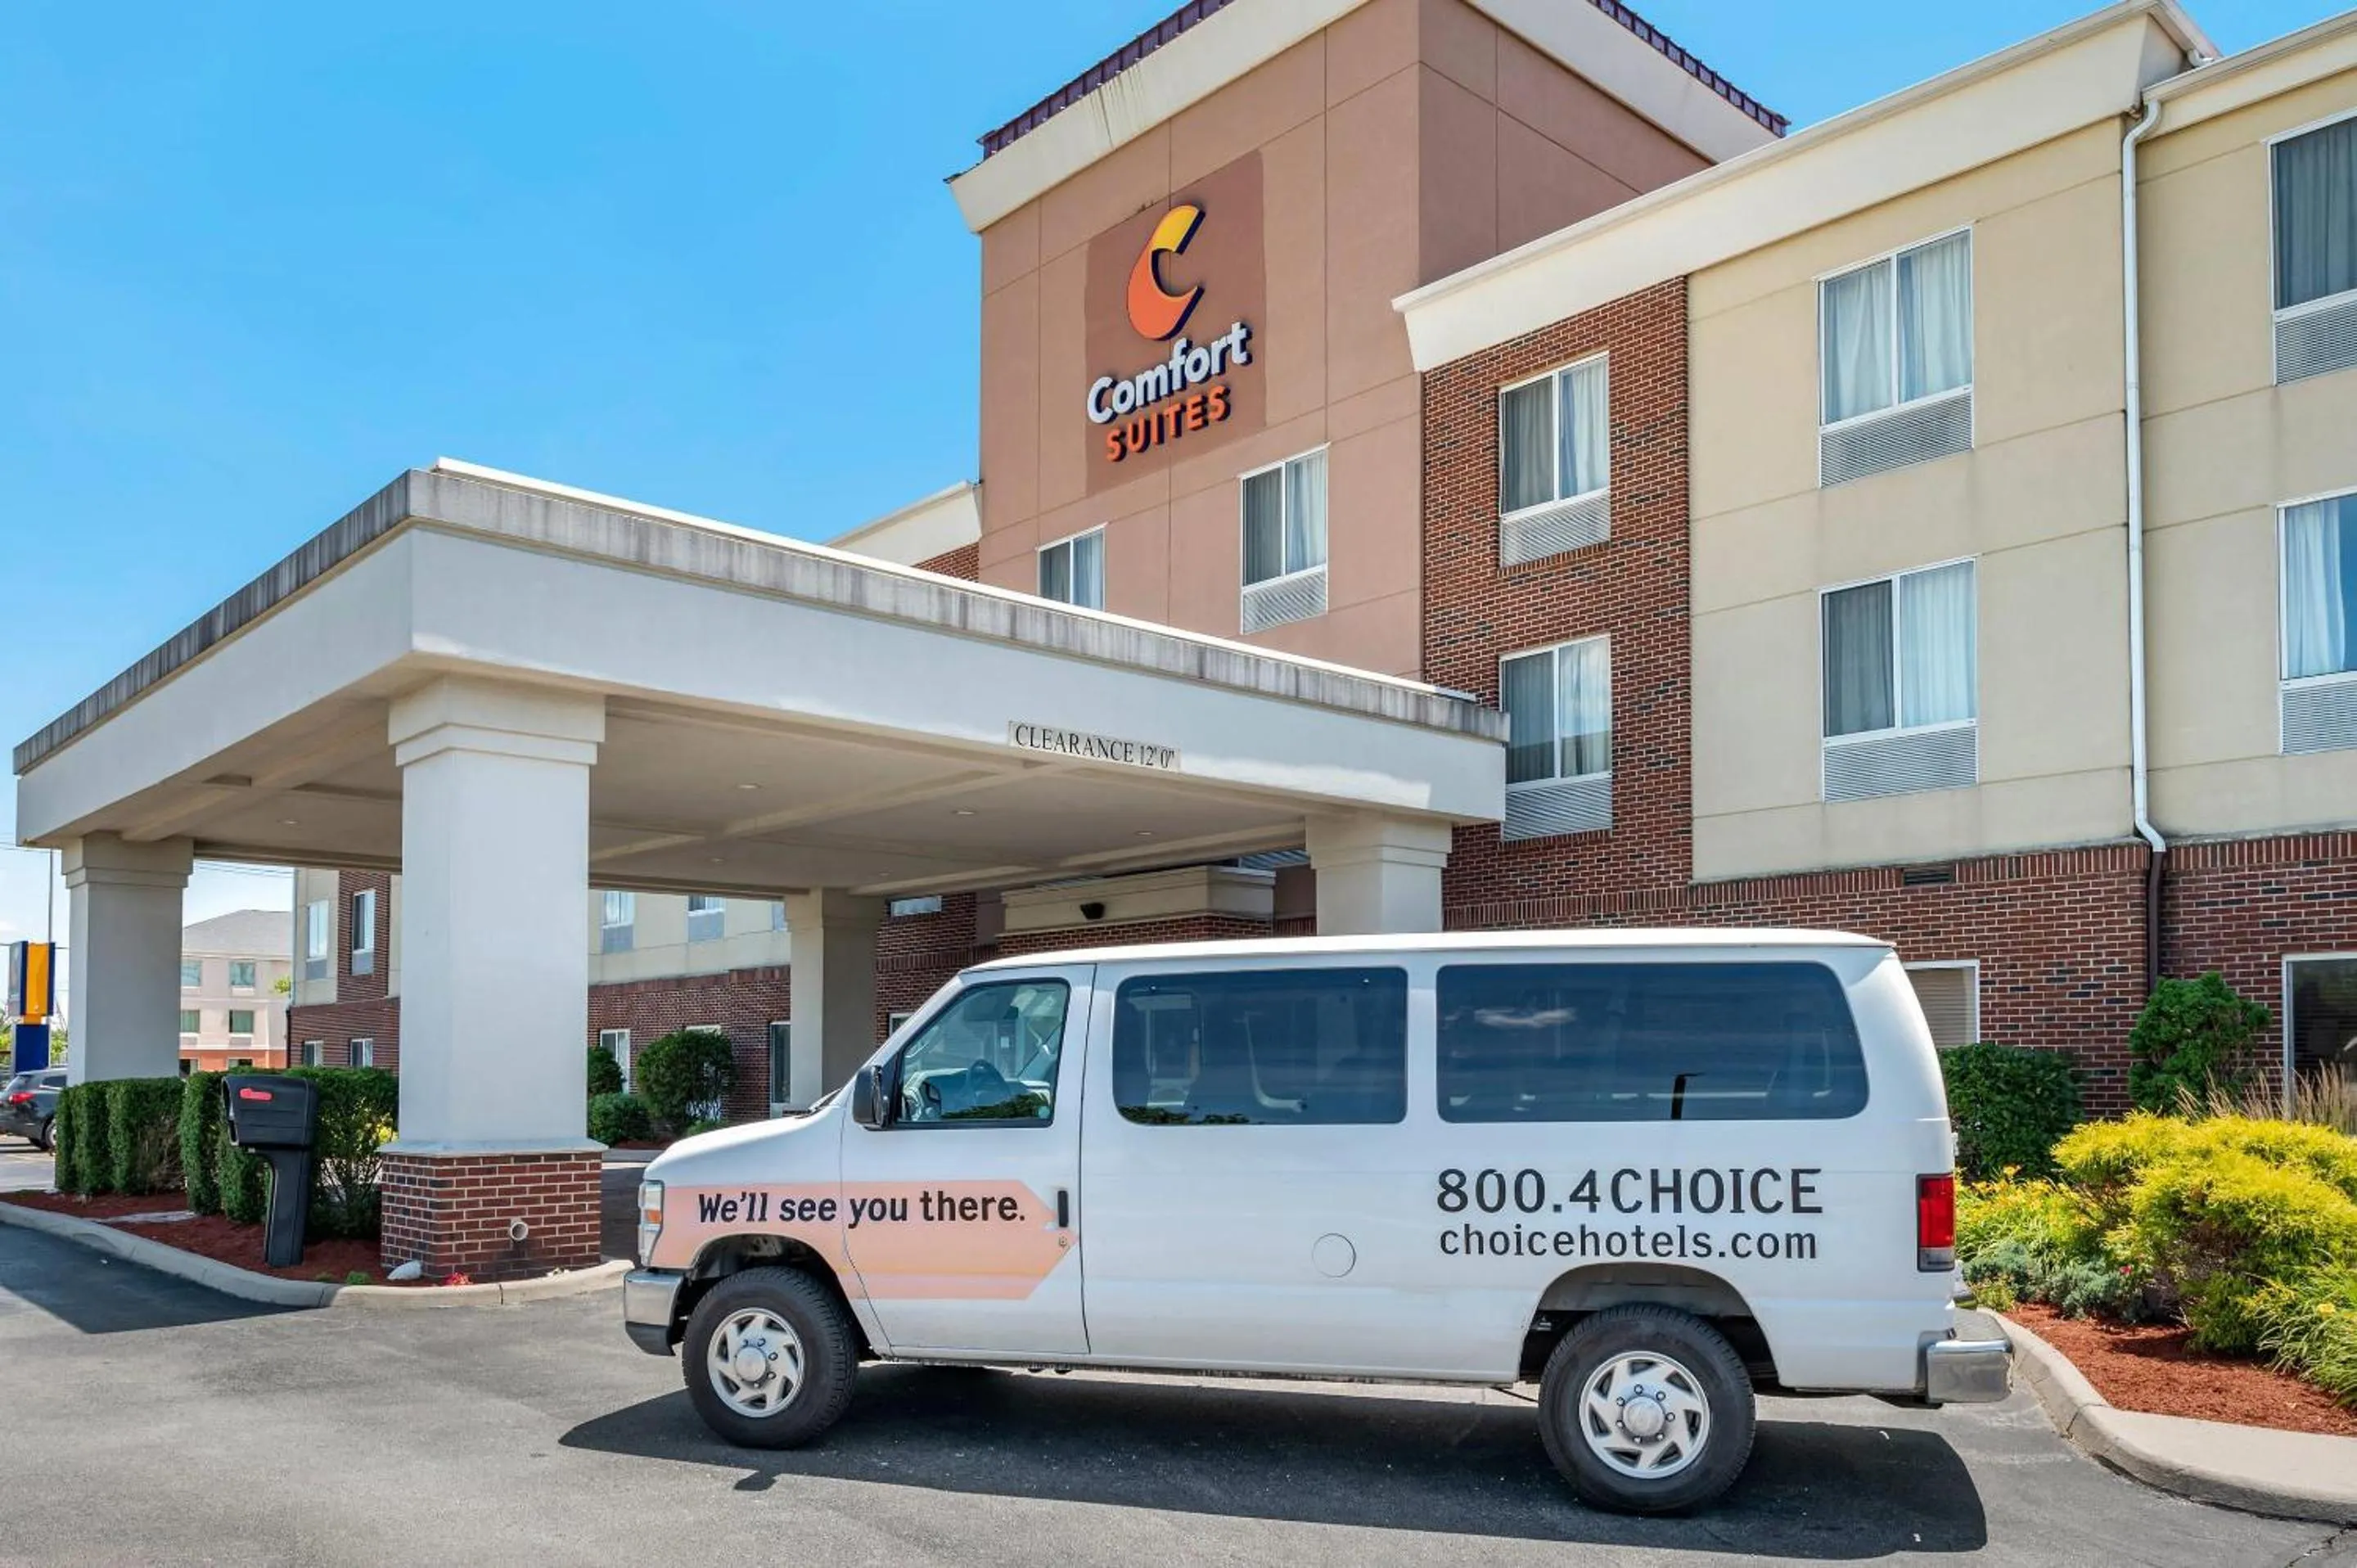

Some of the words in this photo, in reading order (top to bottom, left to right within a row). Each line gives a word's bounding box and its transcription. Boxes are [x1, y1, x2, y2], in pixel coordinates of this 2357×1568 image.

[1088, 322, 1251, 424] Comfort
[1106, 386, 1230, 462] SUITES
[1016, 724, 1133, 762] CLEARANCE
[699, 1192, 768, 1223] We'll
[778, 1197, 836, 1222] see
[848, 1196, 908, 1228] you
[920, 1191, 1025, 1222] there.
[1439, 1224, 1817, 1259] choicehotels.com
